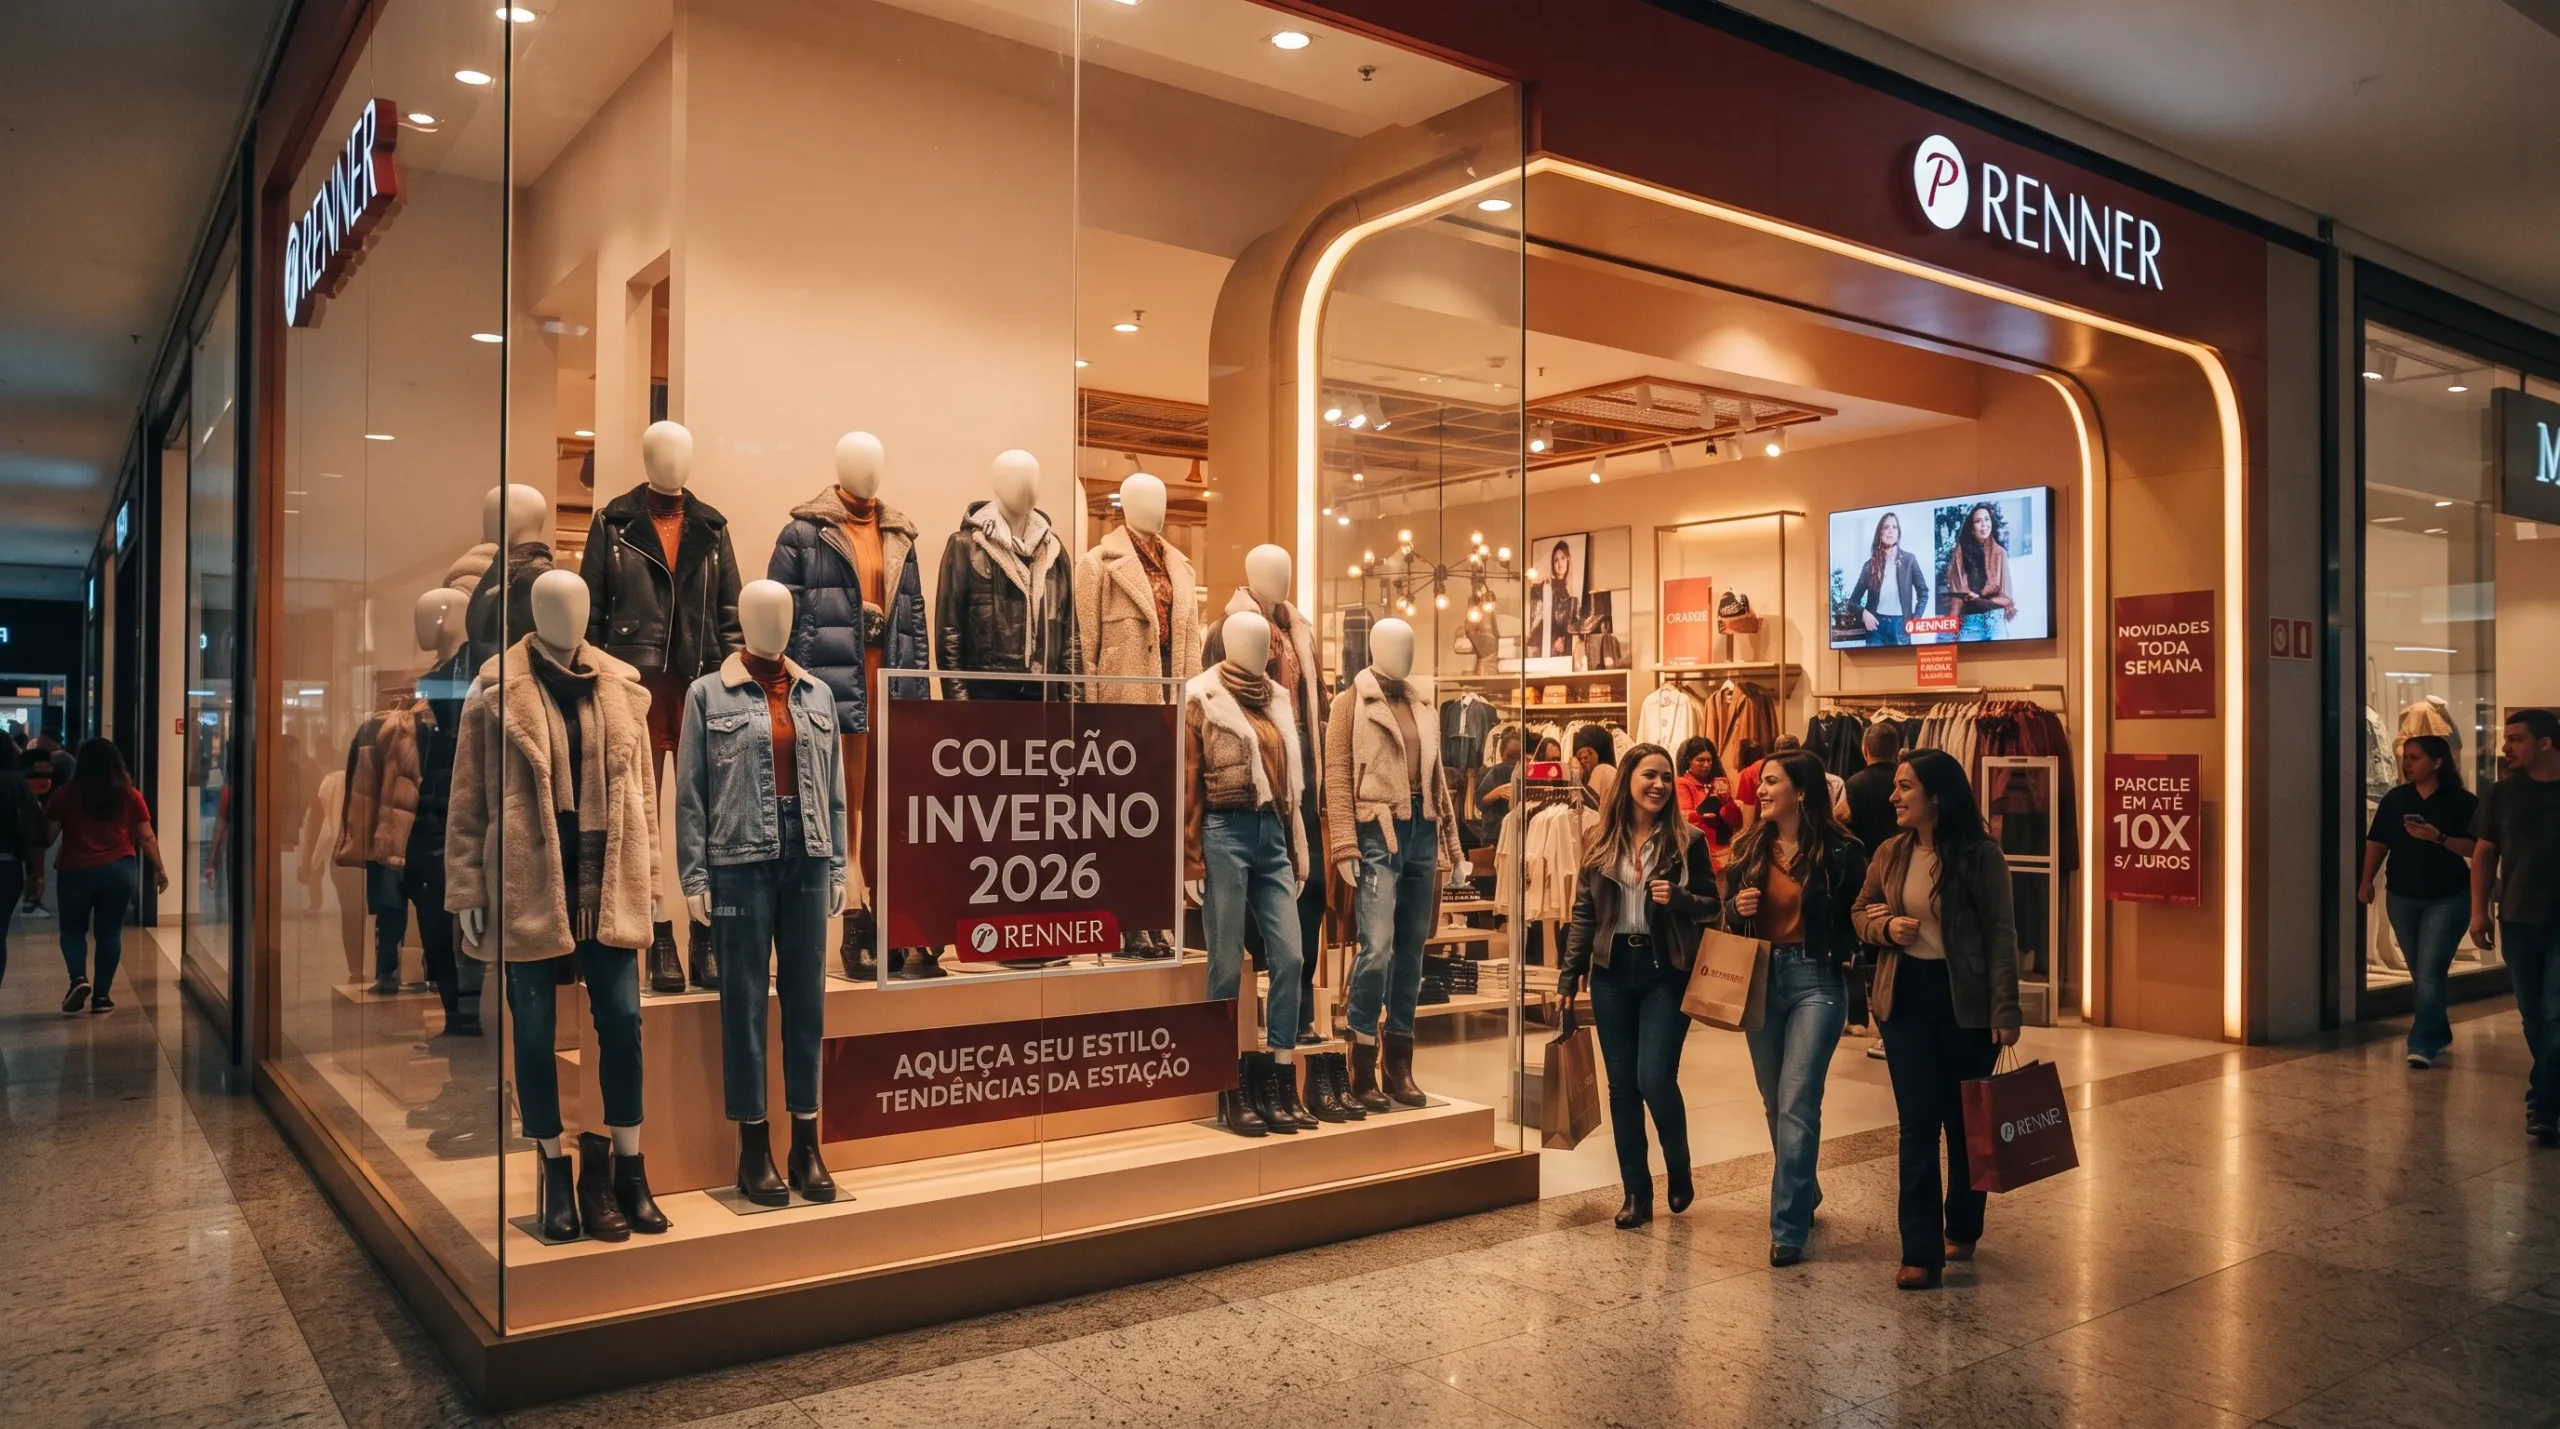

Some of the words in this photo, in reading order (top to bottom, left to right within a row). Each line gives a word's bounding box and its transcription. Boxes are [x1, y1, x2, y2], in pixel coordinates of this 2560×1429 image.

[302, 98, 378, 298] RENNER
[1982, 162, 2163, 291] RENNER
[2118, 620, 2210, 638] NOVIDADES
[2124, 658, 2203, 676] SEMANA
[2138, 640, 2190, 657] TODA
[931, 729, 1137, 787] COLEÇÃO
[2114, 777, 2191, 792] PARCELE
[2122, 796, 2146, 810] EM
[2151, 793, 2183, 811] ATÉ
[908, 791, 1160, 844] INVERNO
[2113, 813, 2192, 851] 10X
[969, 852, 1101, 905] 2026
[2114, 854, 2132, 870] S/
[2134, 854, 2191, 871] JUROS
[1004, 919, 1104, 949] RENNER
[893, 1043, 1015, 1078] AQUEÇA
[1023, 1036, 1074, 1065] SEU
[1082, 1027, 1176, 1058] ESTILO.
[876, 1075, 1041, 1114] TENDÊNCIAS
[1048, 1070, 1081, 1093] DA
[1088, 1052, 1190, 1088] ESTAÇÃO
